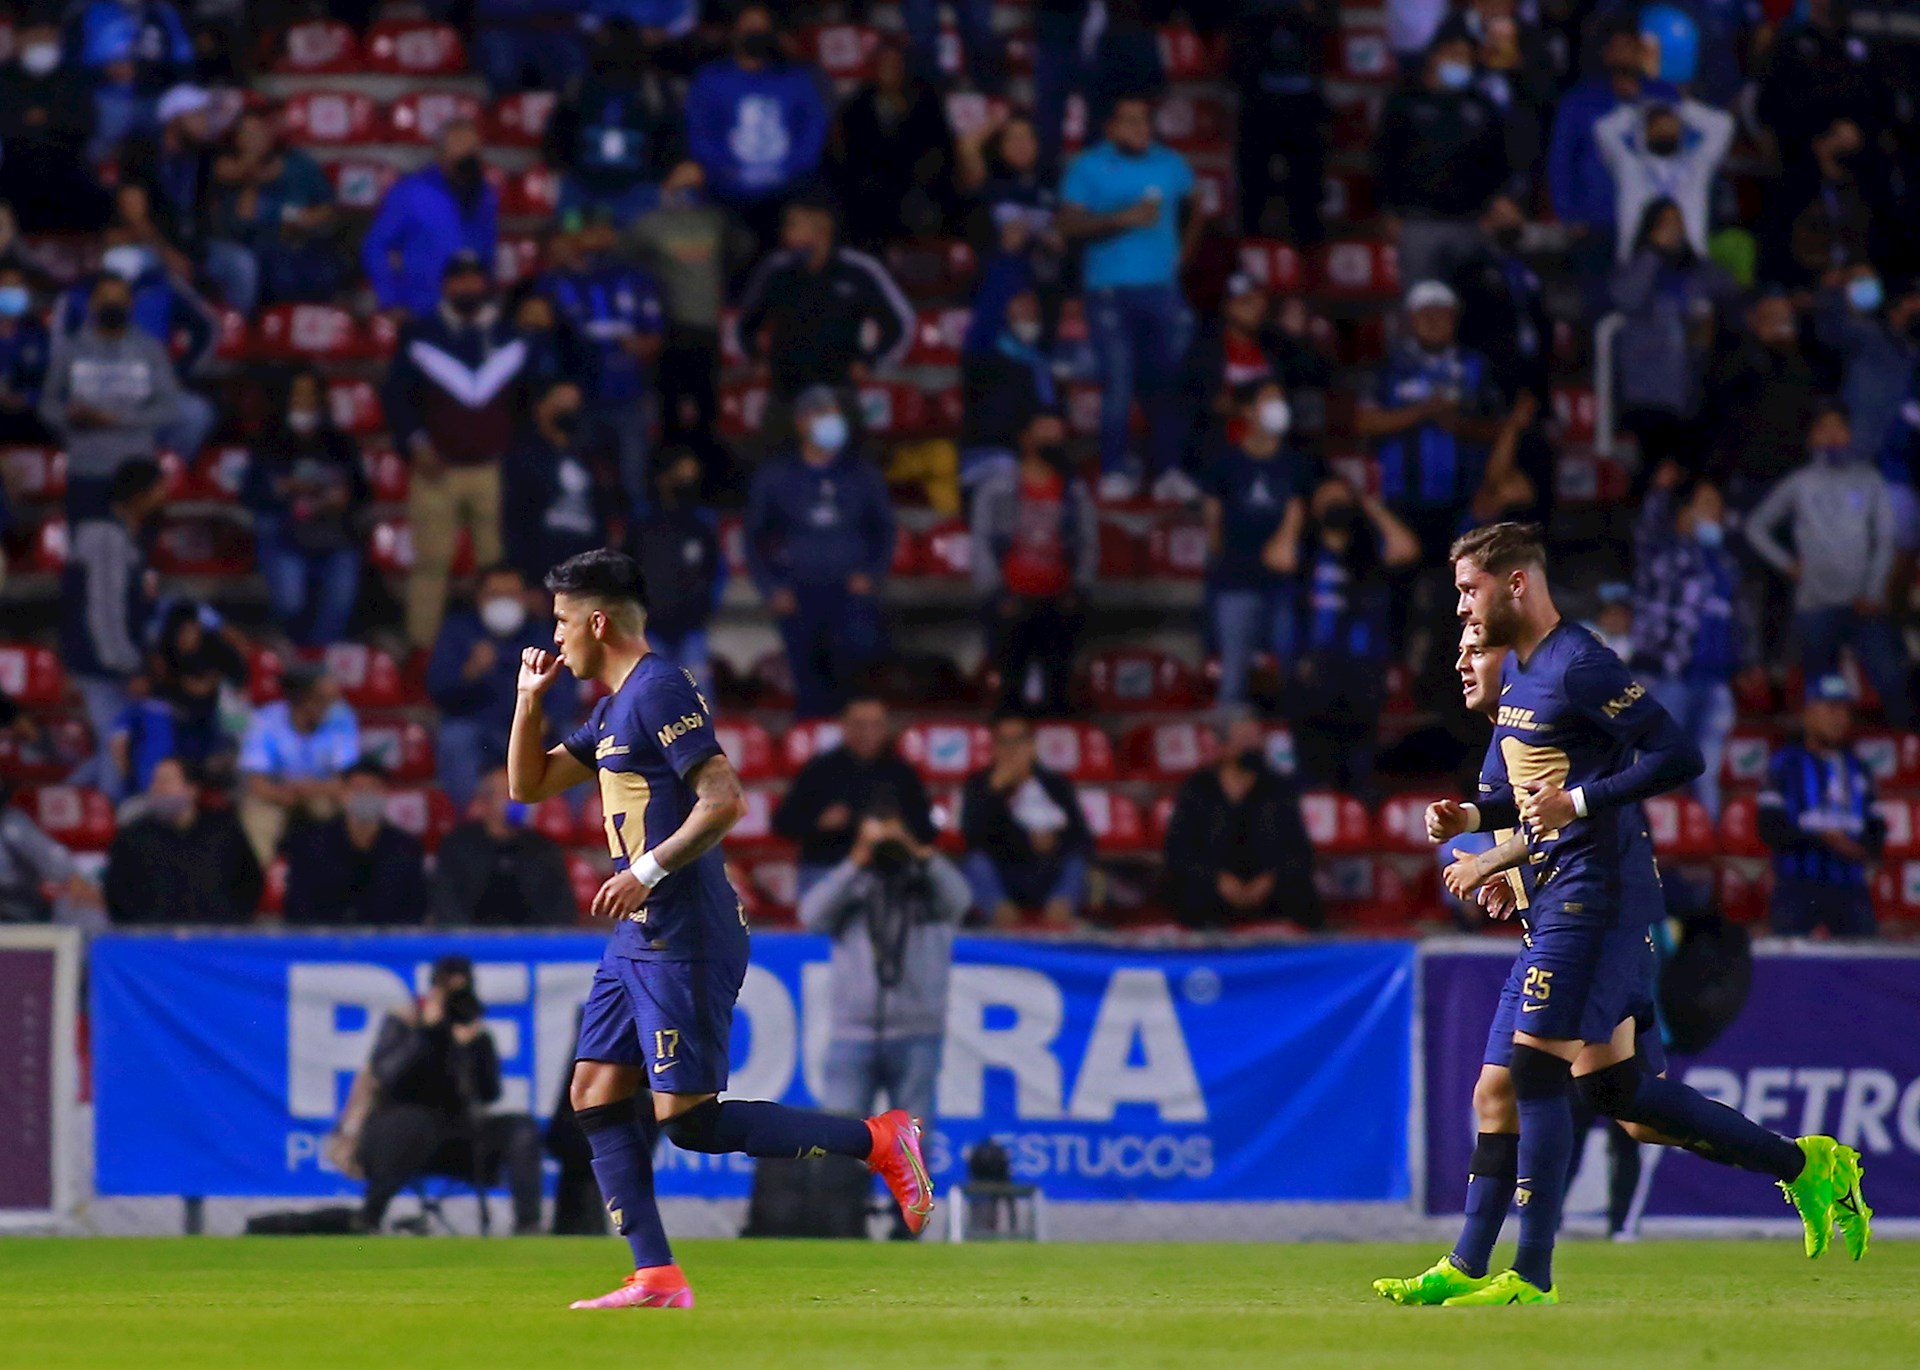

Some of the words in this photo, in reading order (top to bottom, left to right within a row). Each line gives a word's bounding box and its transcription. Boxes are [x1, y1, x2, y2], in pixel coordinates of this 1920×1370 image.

[1497, 705, 1538, 731] DHL
[1522, 966, 1553, 1000] 25
[655, 1029, 679, 1059] 17
